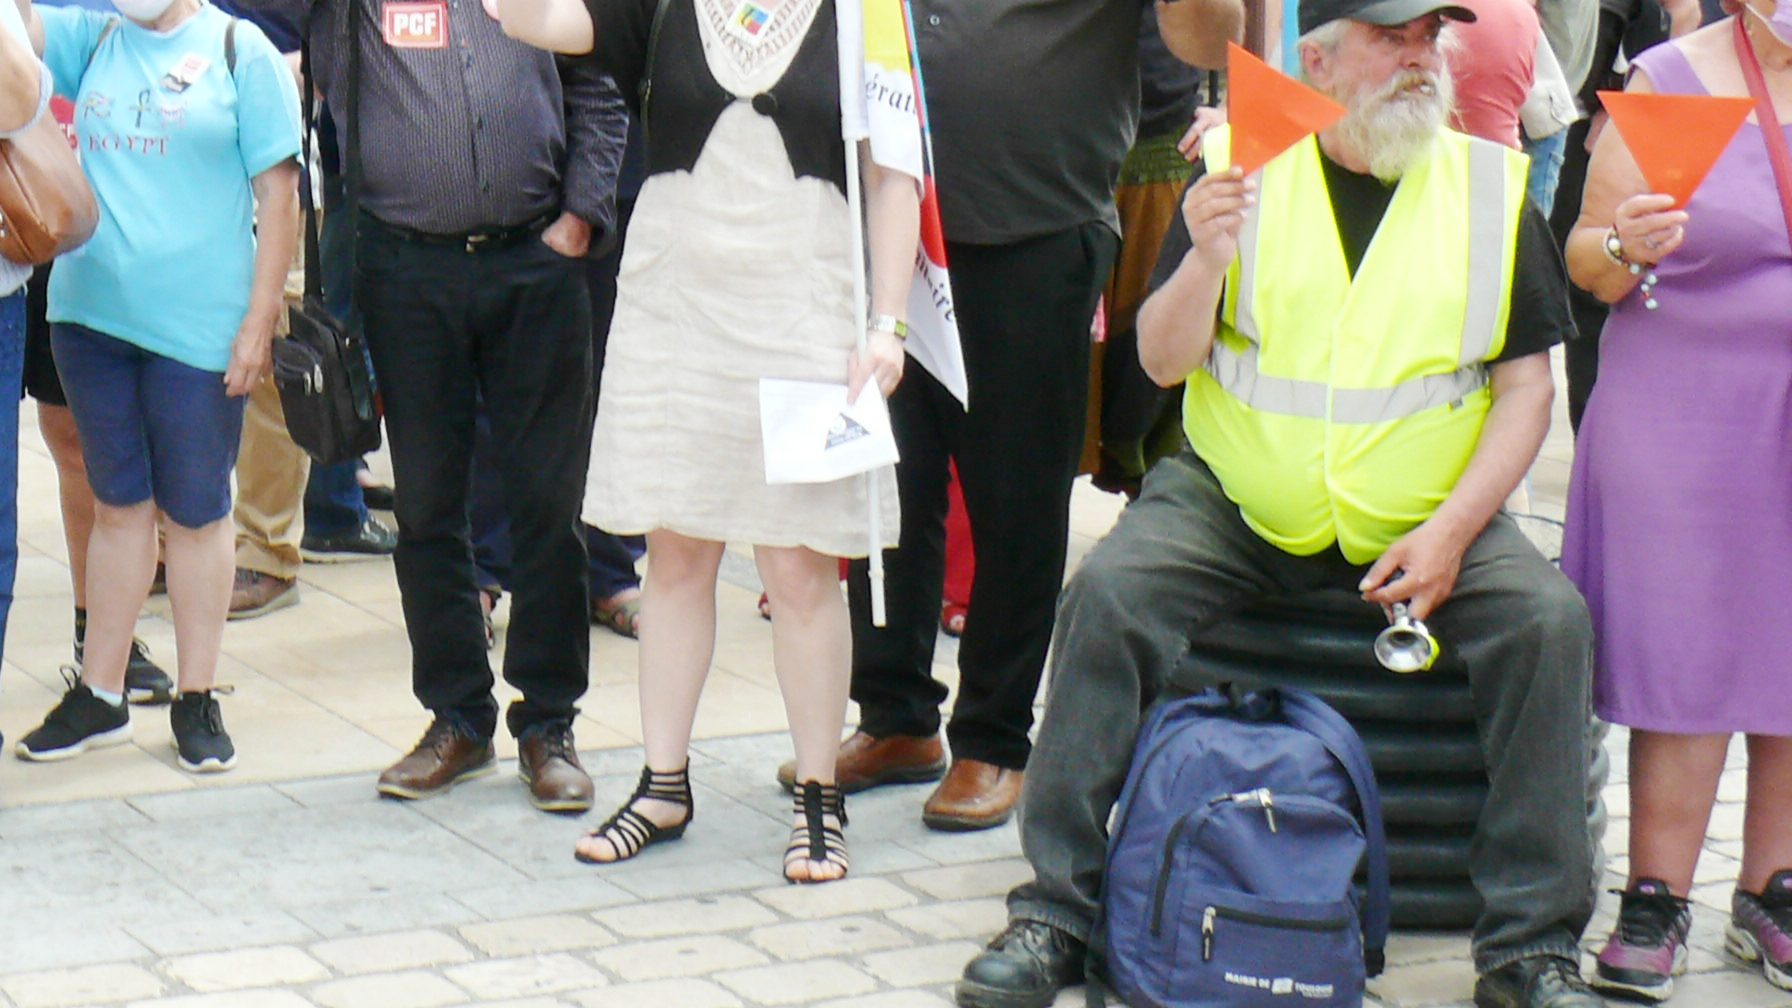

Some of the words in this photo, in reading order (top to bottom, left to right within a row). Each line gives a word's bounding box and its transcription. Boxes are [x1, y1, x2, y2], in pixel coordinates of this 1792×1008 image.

[393, 12, 438, 36] PCF
[864, 72, 918, 116] érat
[88, 134, 169, 156] EGYPT
